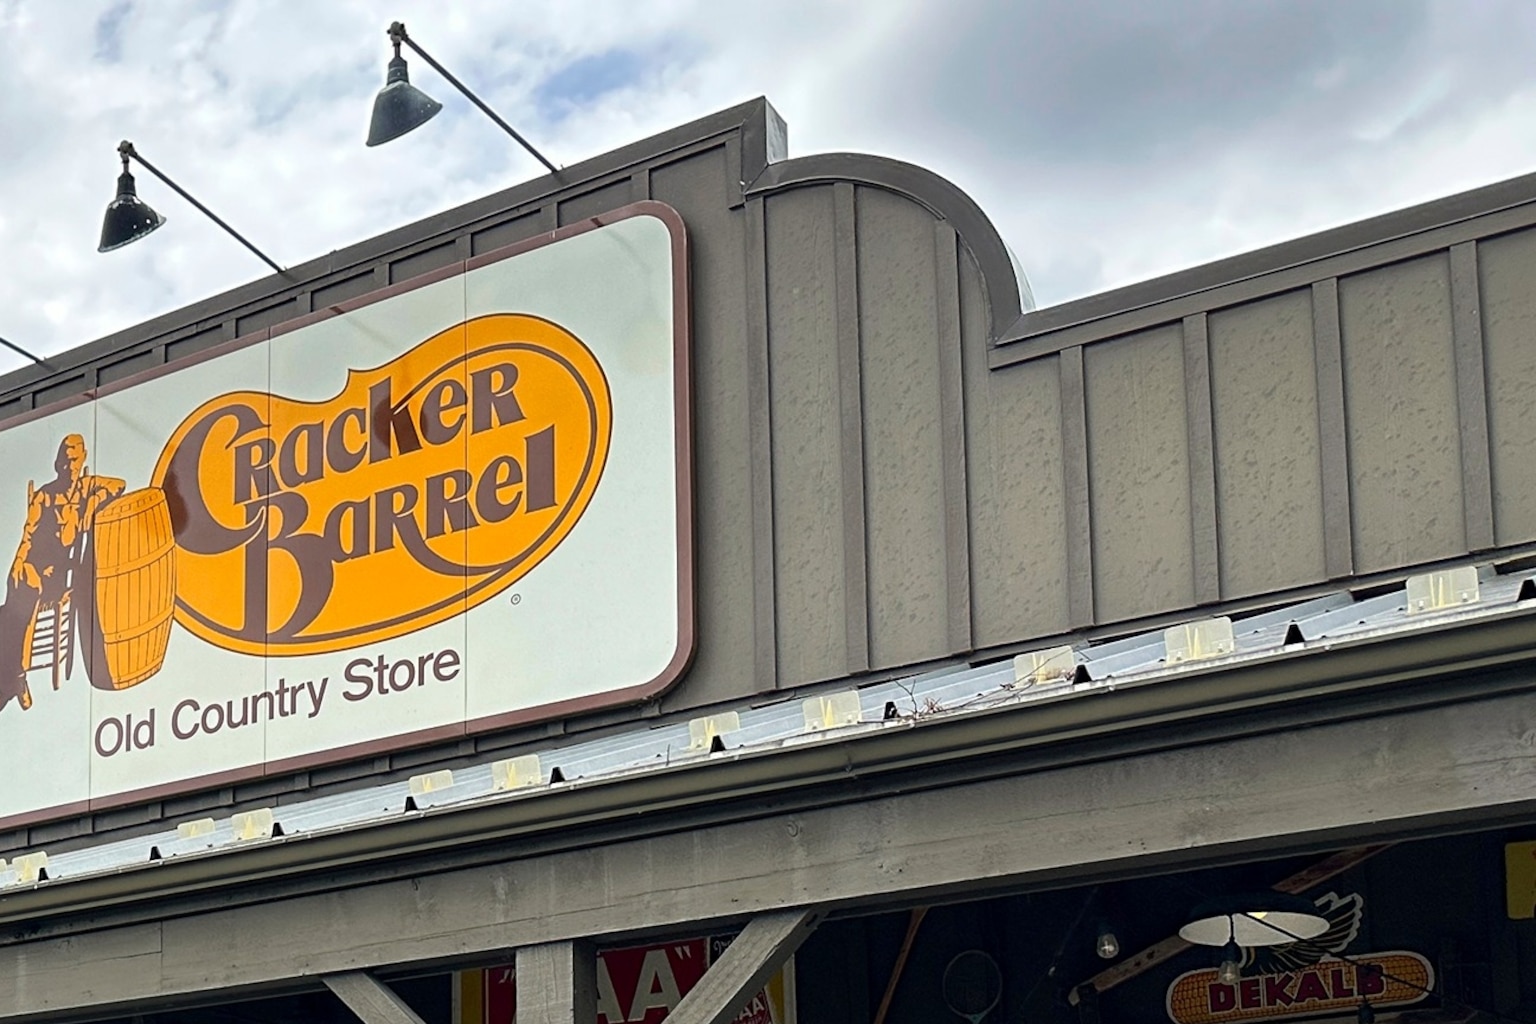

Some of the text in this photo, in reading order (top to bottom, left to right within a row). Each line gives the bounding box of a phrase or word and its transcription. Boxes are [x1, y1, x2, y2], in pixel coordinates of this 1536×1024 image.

[163, 363, 526, 554] Cracker
[244, 424, 557, 641] Barrel
[94, 648, 461, 758] Old Country Store
[1208, 963, 1385, 1014] DEKALB
